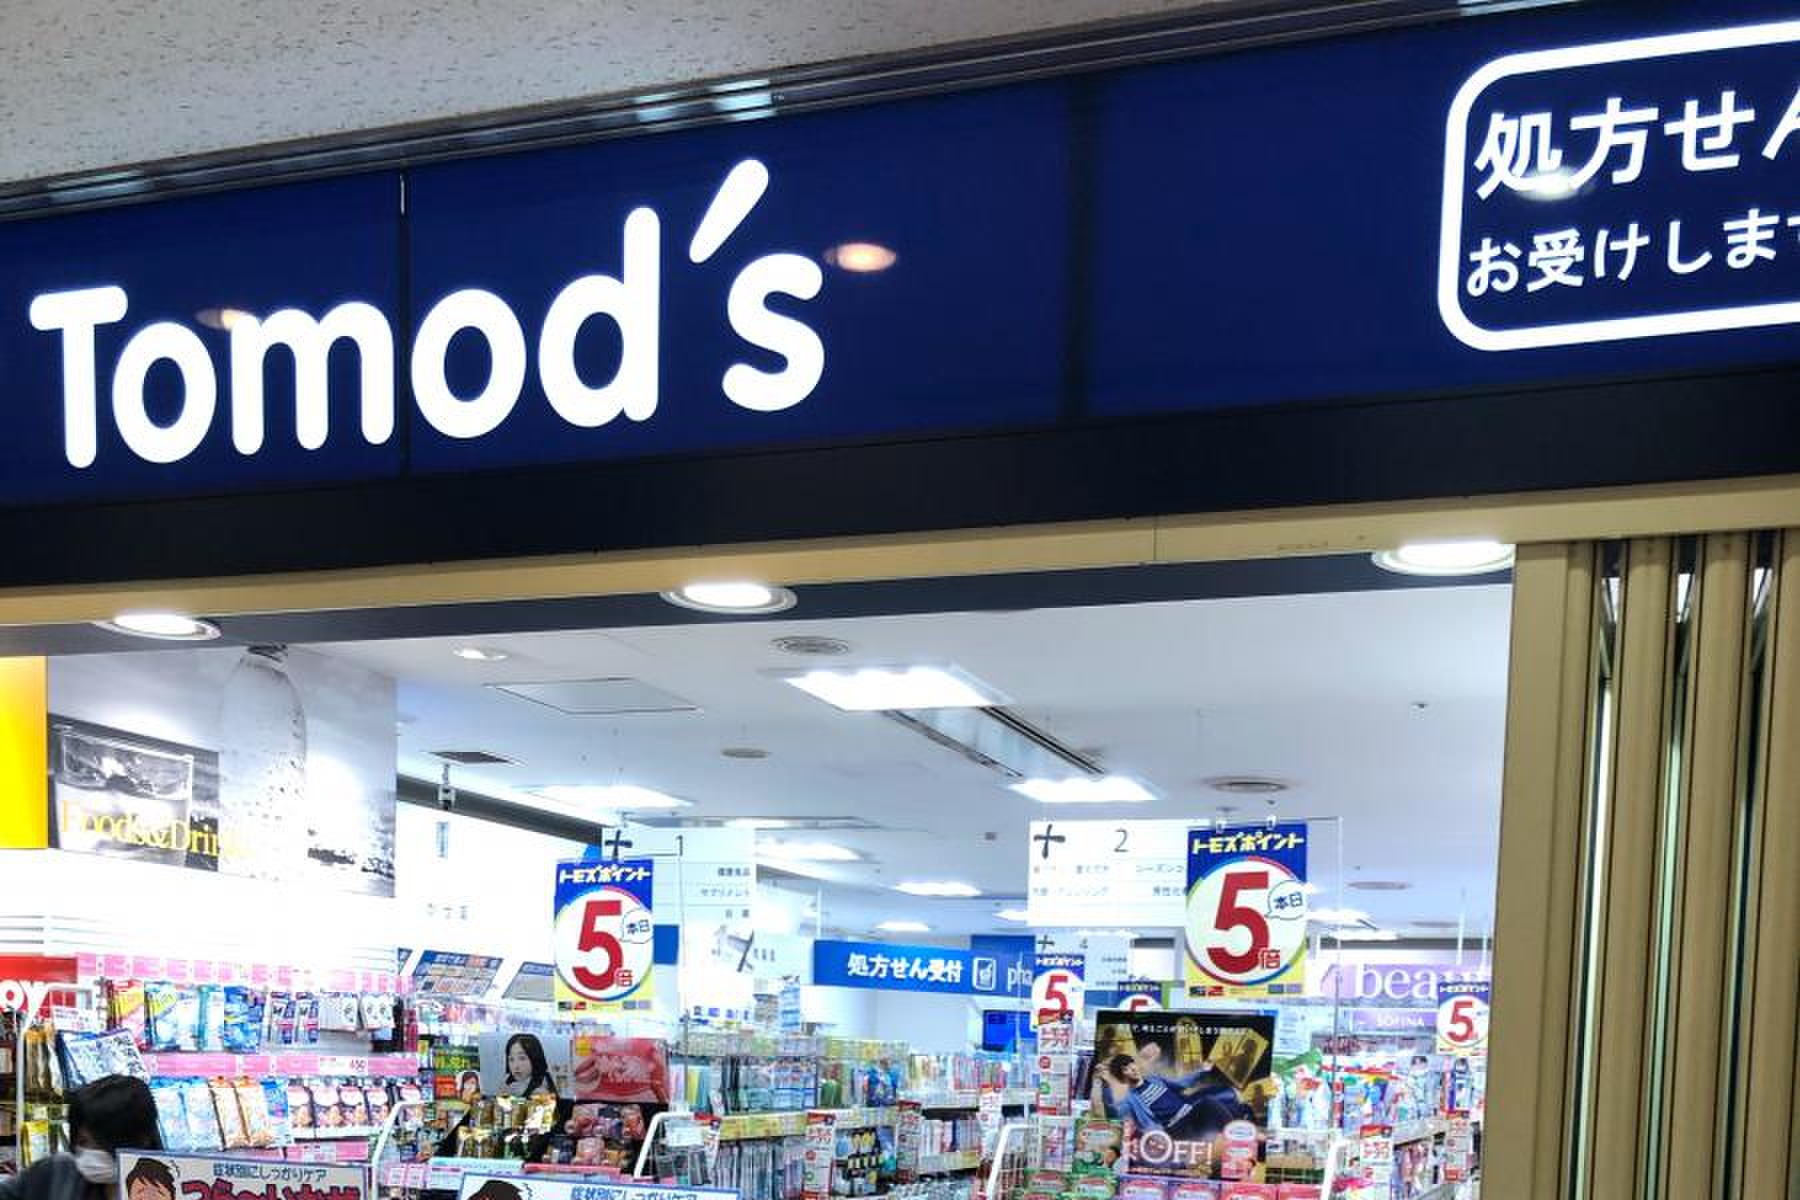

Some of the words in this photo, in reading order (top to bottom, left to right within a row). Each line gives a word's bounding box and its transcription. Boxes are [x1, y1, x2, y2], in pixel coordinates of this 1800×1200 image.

[1466, 207, 1800, 297] お受けしま
[28, 157, 825, 470] Tomod's
[1192, 831, 1304, 855] トモズポイント
[559, 865, 651, 884] トモズポイント
[1272, 891, 1304, 911] 本日
[626, 918, 651, 936] 本日
[1207, 871, 1270, 974] 5
[573, 900, 623, 991] 5
[847, 951, 963, 983] 処方せん受付
[1447, 1000, 1475, 1042] 5
